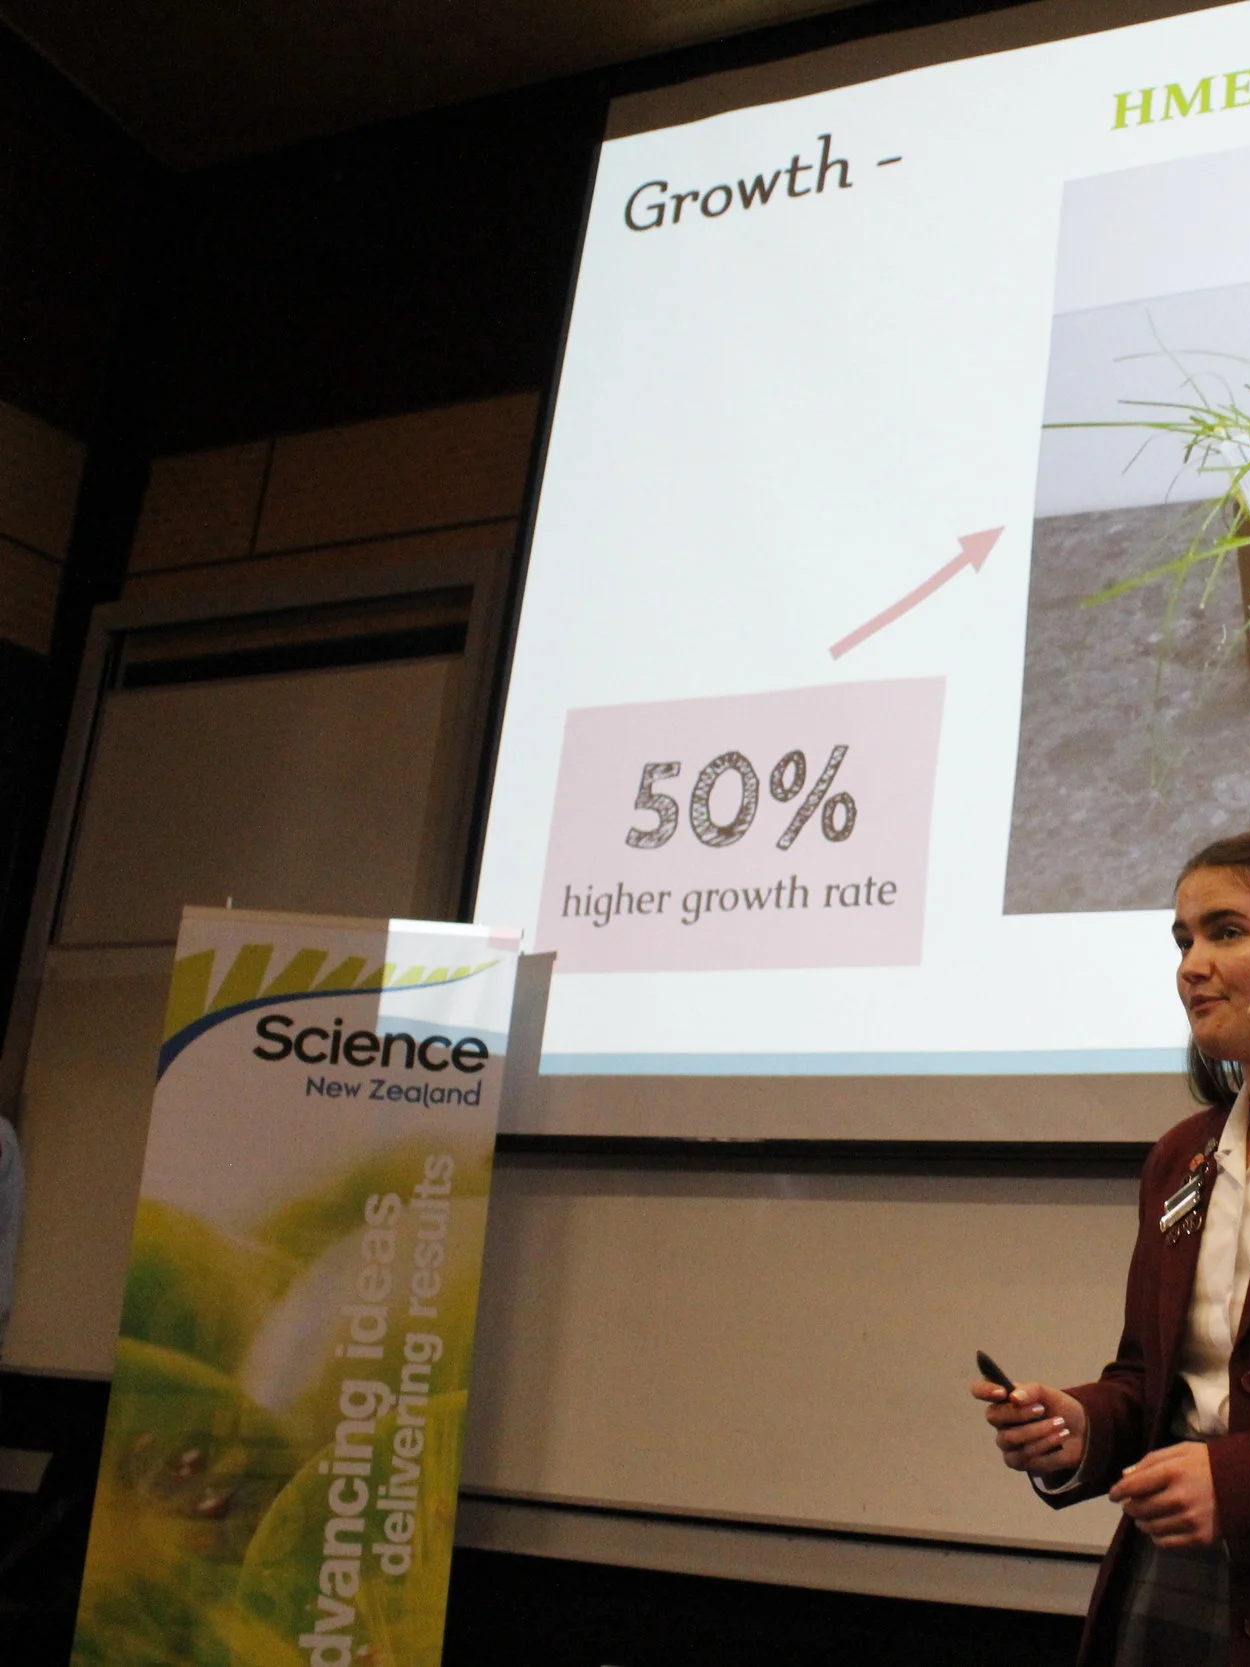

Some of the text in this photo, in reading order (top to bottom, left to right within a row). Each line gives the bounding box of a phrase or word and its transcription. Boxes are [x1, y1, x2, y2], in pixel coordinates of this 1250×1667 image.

[624, 134, 853, 232] Growth
[625, 744, 858, 851] 50%
[561, 874, 899, 928] higher growth rate
[252, 1014, 489, 1074] Science
[306, 1076, 483, 1107] New Zealand
[334, 1192, 402, 1360] ideas
[371, 1153, 454, 1576] delivering results
